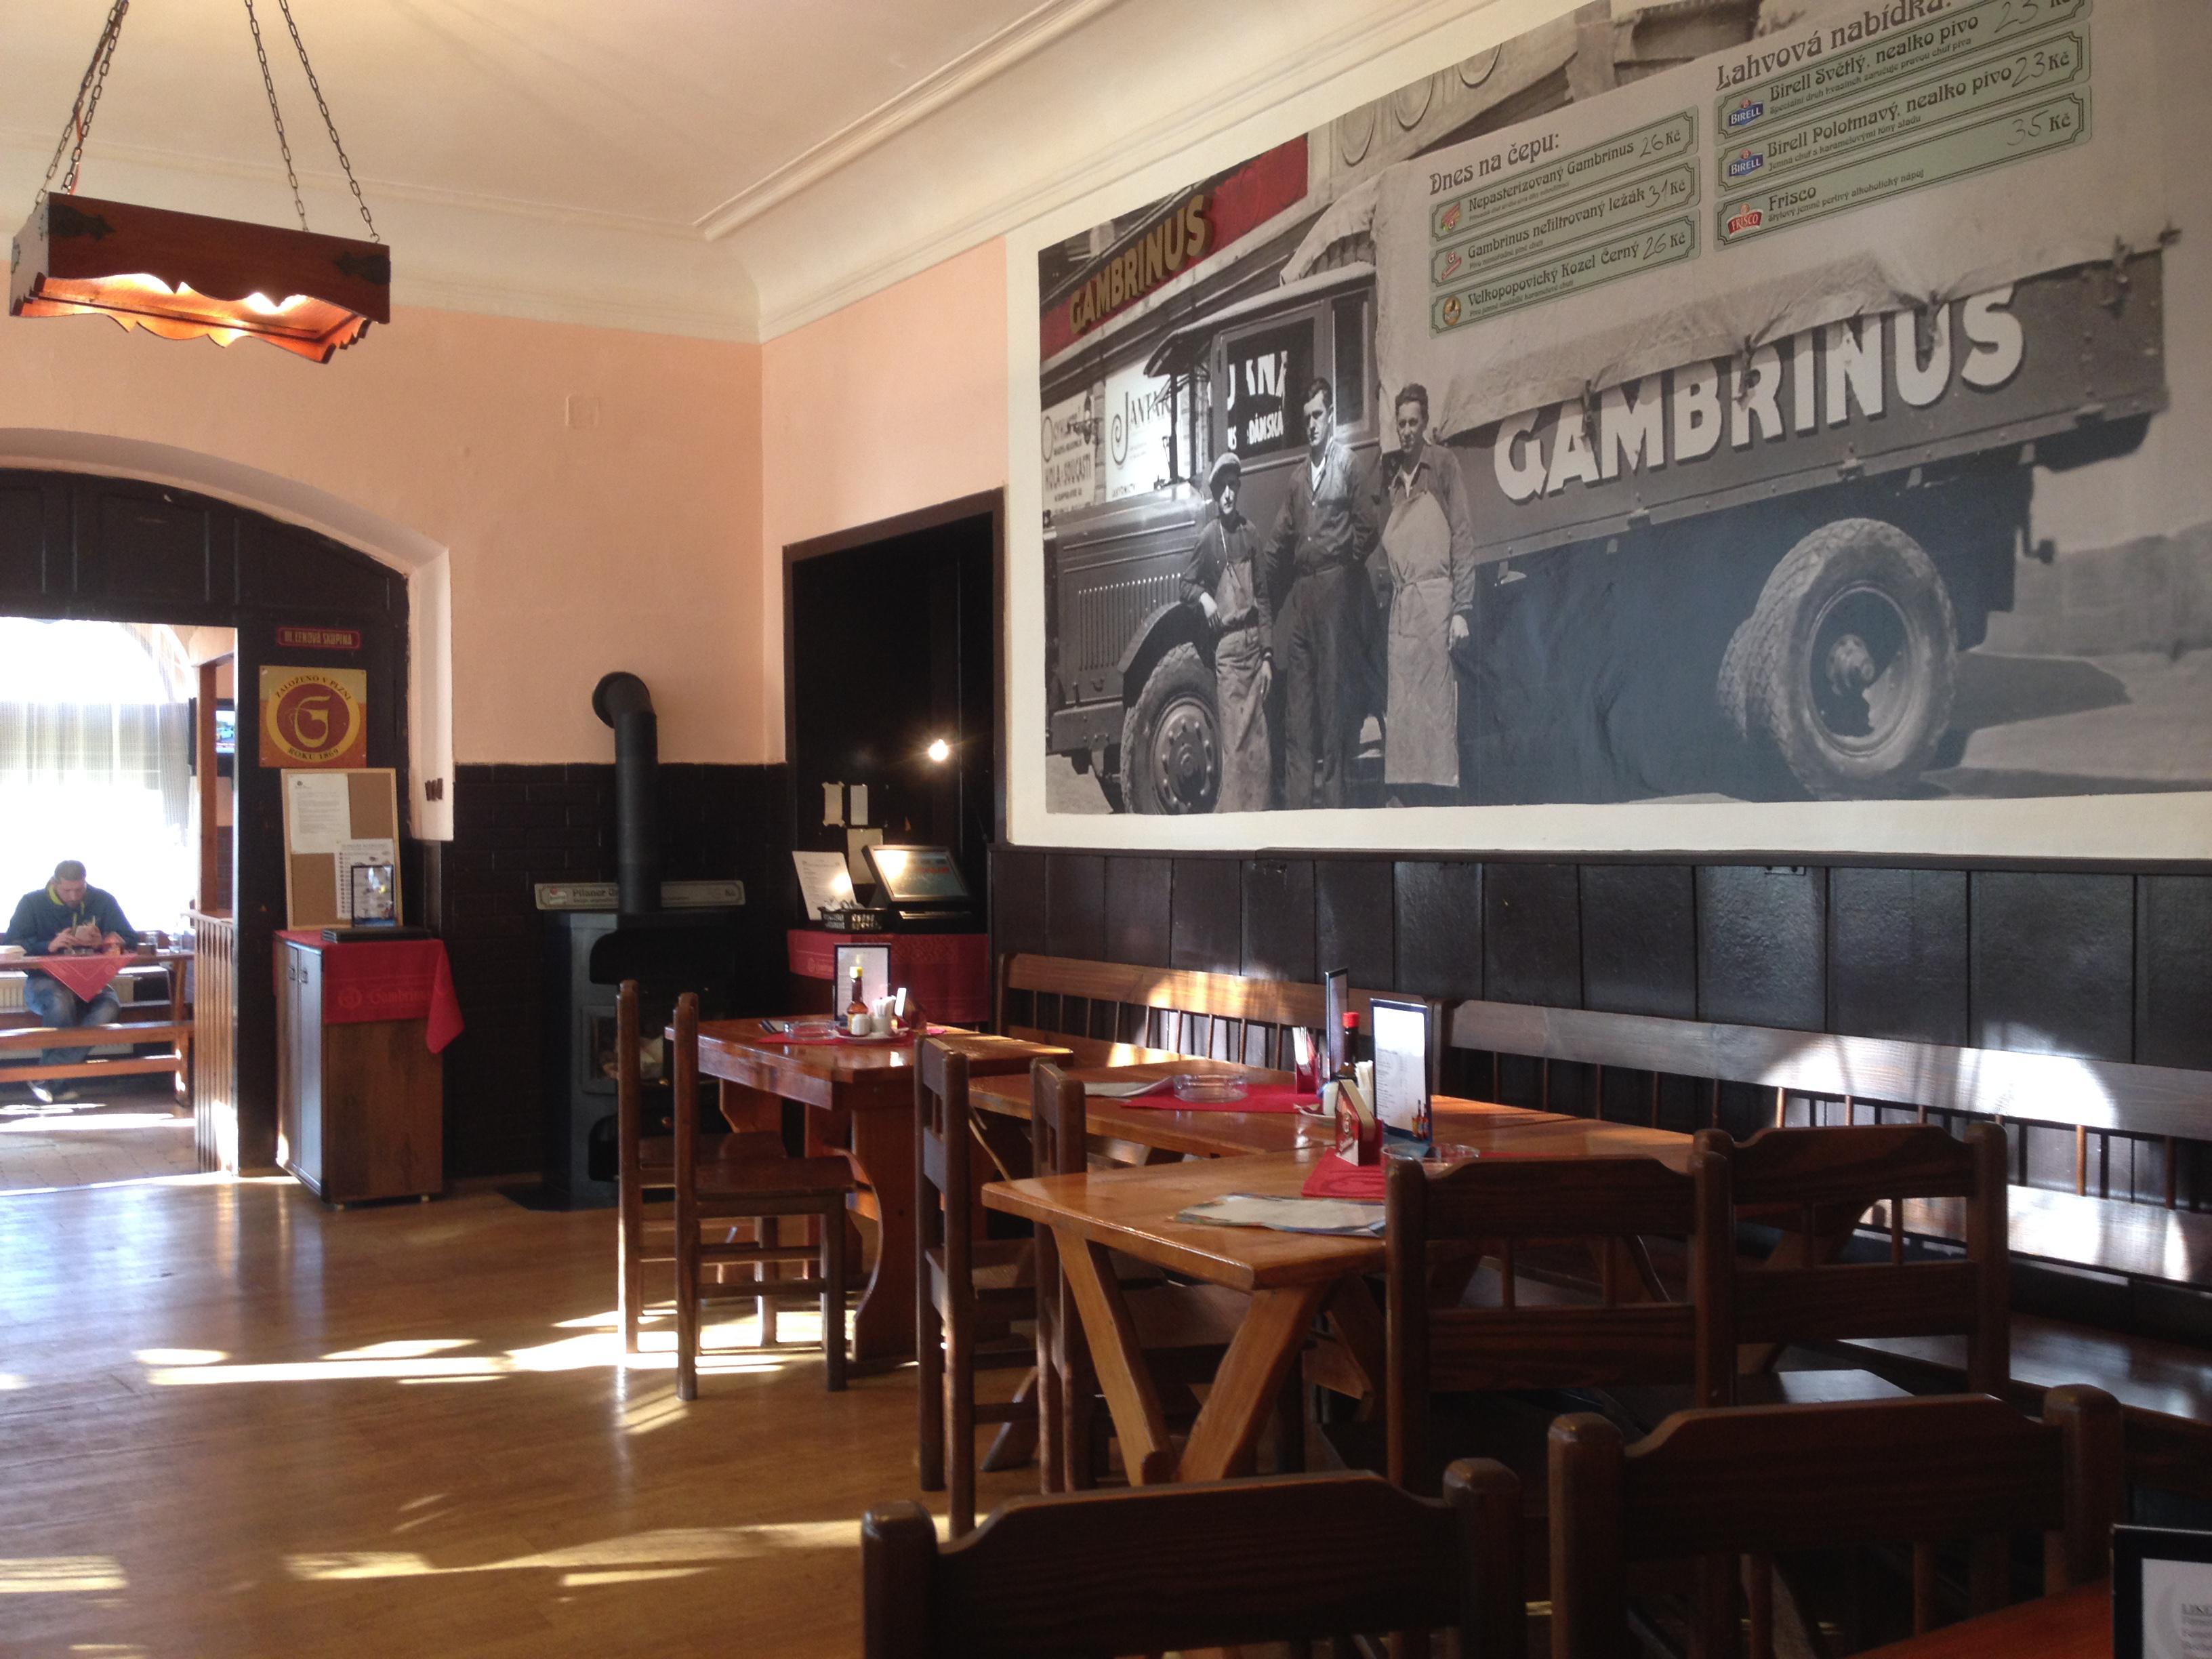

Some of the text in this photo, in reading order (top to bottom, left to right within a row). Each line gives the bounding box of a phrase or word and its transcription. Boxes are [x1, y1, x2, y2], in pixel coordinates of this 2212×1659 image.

[1716, 30, 1823, 91] Lahvová
[1769, 73, 1811, 102] Birell
[1876, 32, 1934, 64] nealko
[1940, 16, 1979, 44] pivo
[1901, 52, 1930, 68] pravou
[1730, 106, 1761, 125] BIRELL
[1767, 131, 1807, 158] Birell
[1906, 81, 1966, 112] nealko
[1971, 67, 2011, 95] pivo
[2011, 52, 2046, 87] 23
[2048, 52, 2070, 70] Kč
[1429, 134, 1559, 195] Dnes na čepu:
[1469, 166, 1563, 211] Nepasterizovaný
[1567, 142, 1634, 175] Gambrinus
[1639, 134, 1664, 158] 26
[1665, 129, 1681, 145] Kč
[1730, 159, 1761, 174] BIRELL
[1769, 110, 2071, 211] Frisco 35 Kč
[1900, 169, 1924, 184] nápoj
[1468, 230, 1530, 259] Gambrinus
[1532, 203, 1605, 237] nefiltrovaný
[1609, 187, 1645, 211] ležák
[1645, 179, 1668, 208] 31
[1670, 180, 1686, 195] Kč
[1730, 213, 1759, 232] FRISCO
[1069, 194, 1210, 334] GAMBRINUS
[1467, 267, 1558, 306] Velkopopovický
[1561, 255, 1596, 278] Kozel
[1601, 241, 1639, 265] Černý
[1643, 233, 1667, 260] 26
[1670, 232, 1686, 248] Kč
[1494, 286, 2026, 501] GAMBRINUS
[287, 747, 340, 760] ROKU 1869
